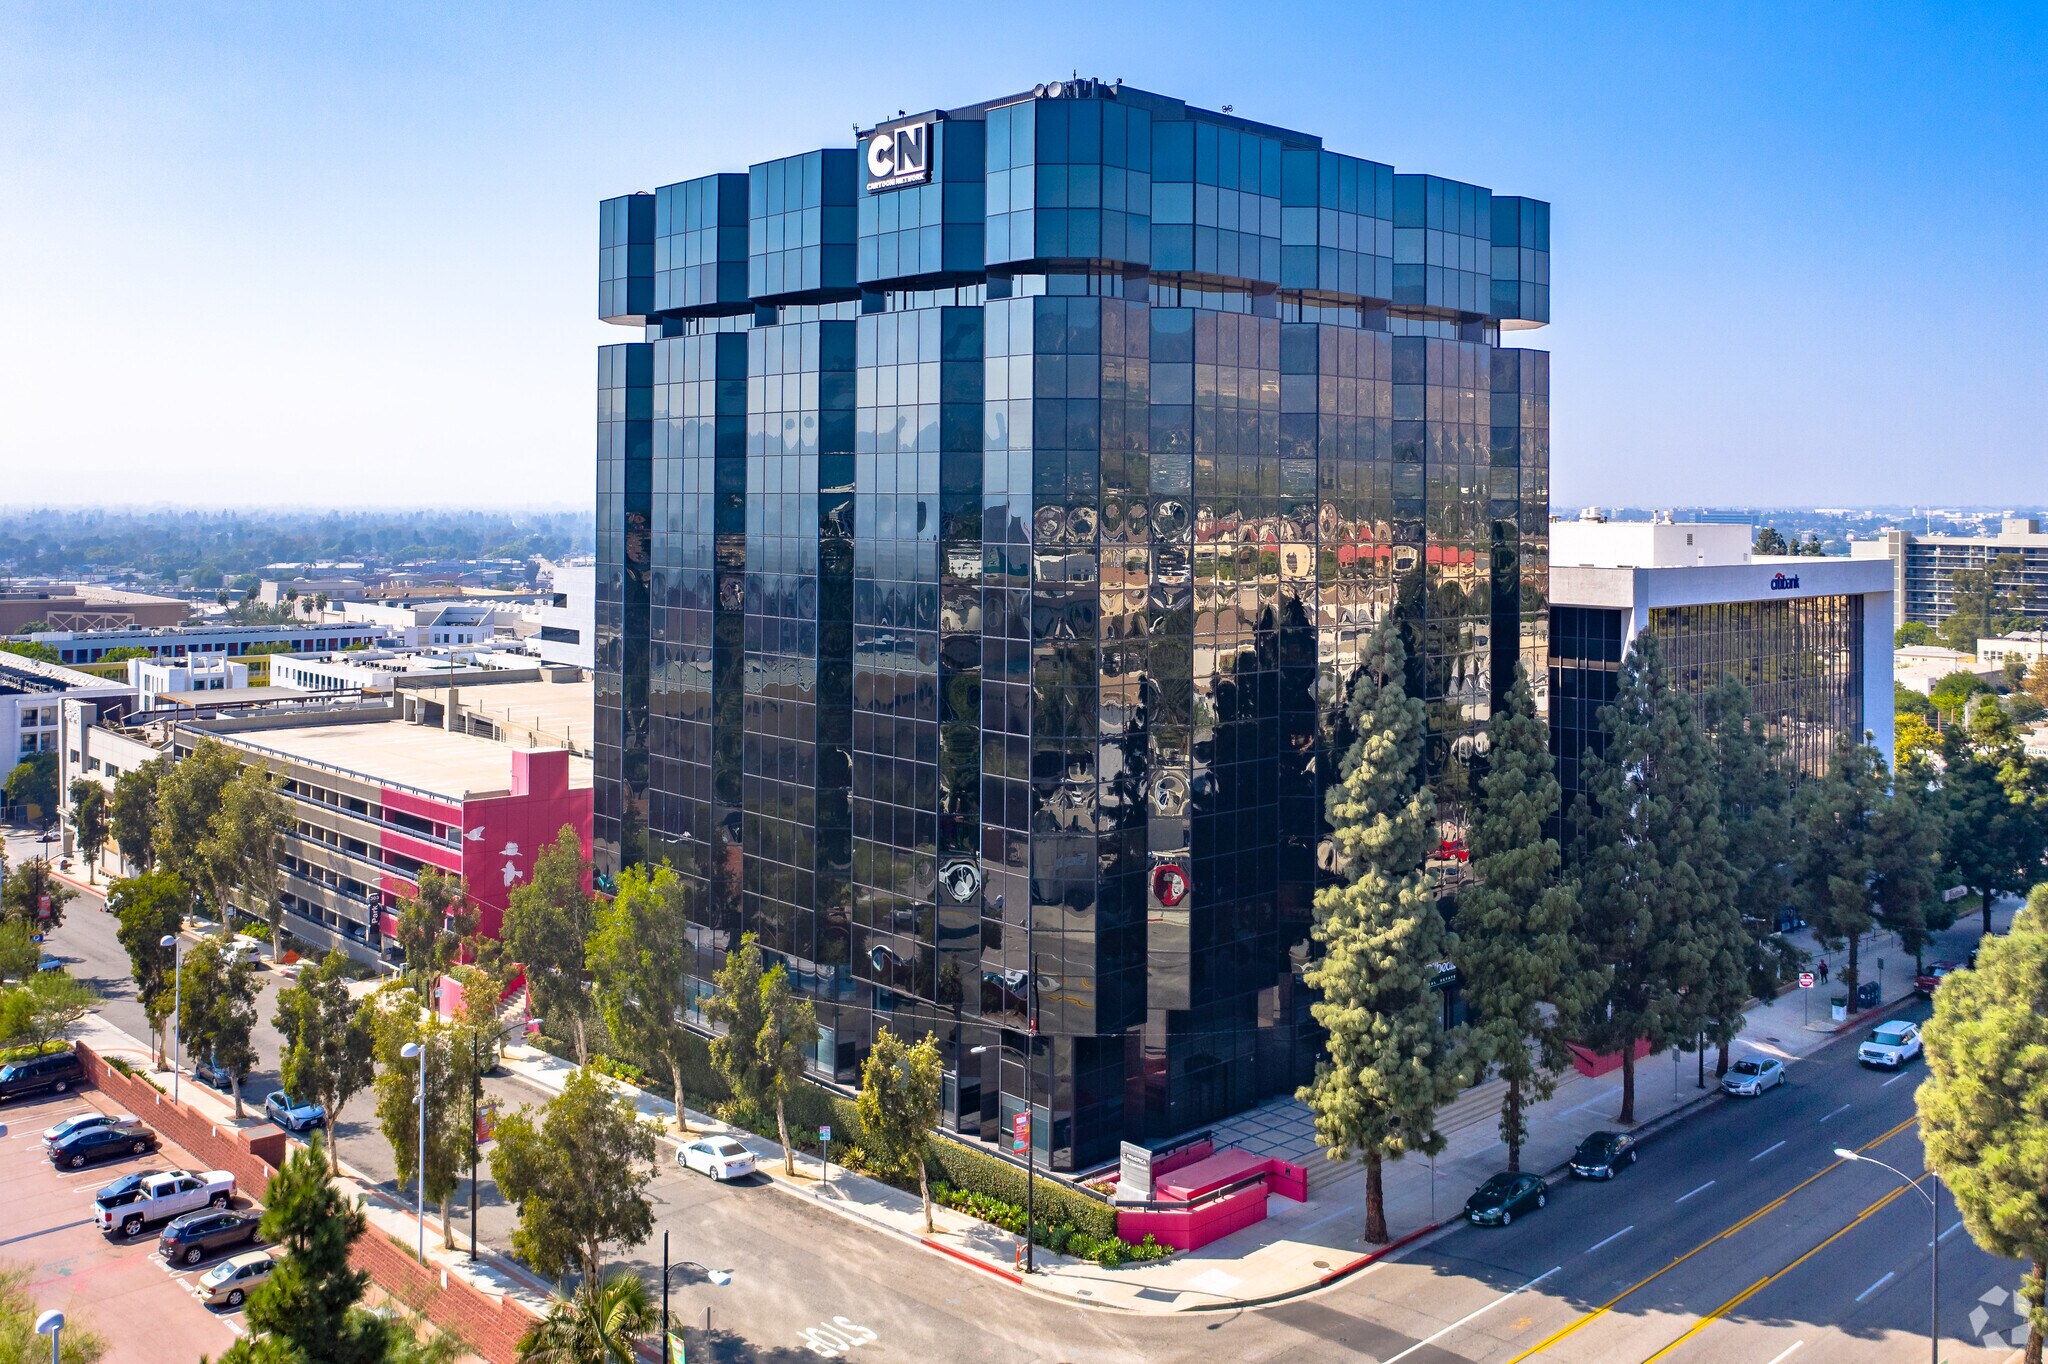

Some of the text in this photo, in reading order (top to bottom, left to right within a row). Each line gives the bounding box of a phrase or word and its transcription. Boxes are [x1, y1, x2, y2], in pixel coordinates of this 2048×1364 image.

[867, 122, 926, 178] CN
[866, 172, 925, 191] CARTOON NETWORK
[371, 904, 379, 924] Park
[796, 1315, 878, 1358] STOP
